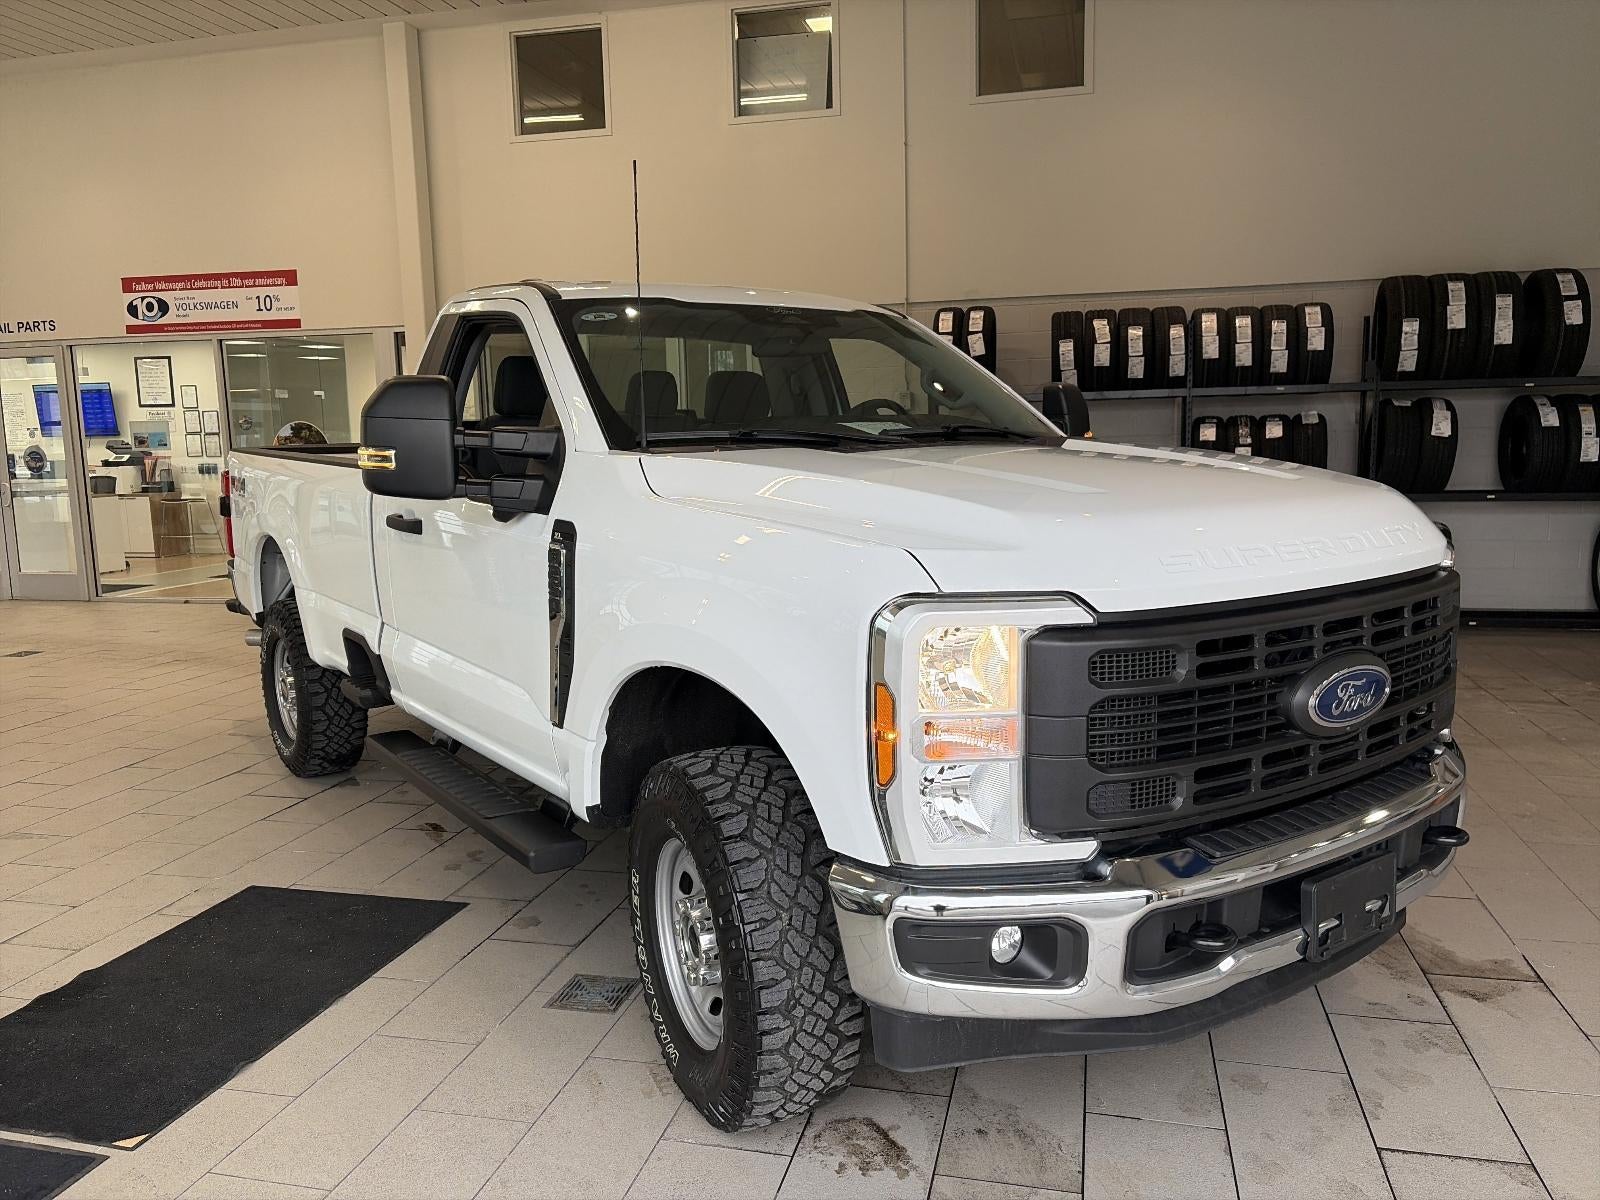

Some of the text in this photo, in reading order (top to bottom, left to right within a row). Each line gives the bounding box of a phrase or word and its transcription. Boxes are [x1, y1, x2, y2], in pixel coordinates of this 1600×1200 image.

[132, 281, 154, 291] Faulkner
[154, 280, 186, 291] Volkswagen
[191, 278, 221, 289] Celebrating
[221, 276, 229, 287] its
[229, 277, 242, 287] 10th
[242, 278, 254, 288] year
[132, 297, 159, 320] 10
[175, 300, 239, 311] VOLKSWAGEN
[17, 319, 56, 333] PARTS
[1158, 520, 1426, 575] SUPER DUTY
[1331, 677, 1376, 716] Ford
[631, 868, 680, 1067] WRANGLER
